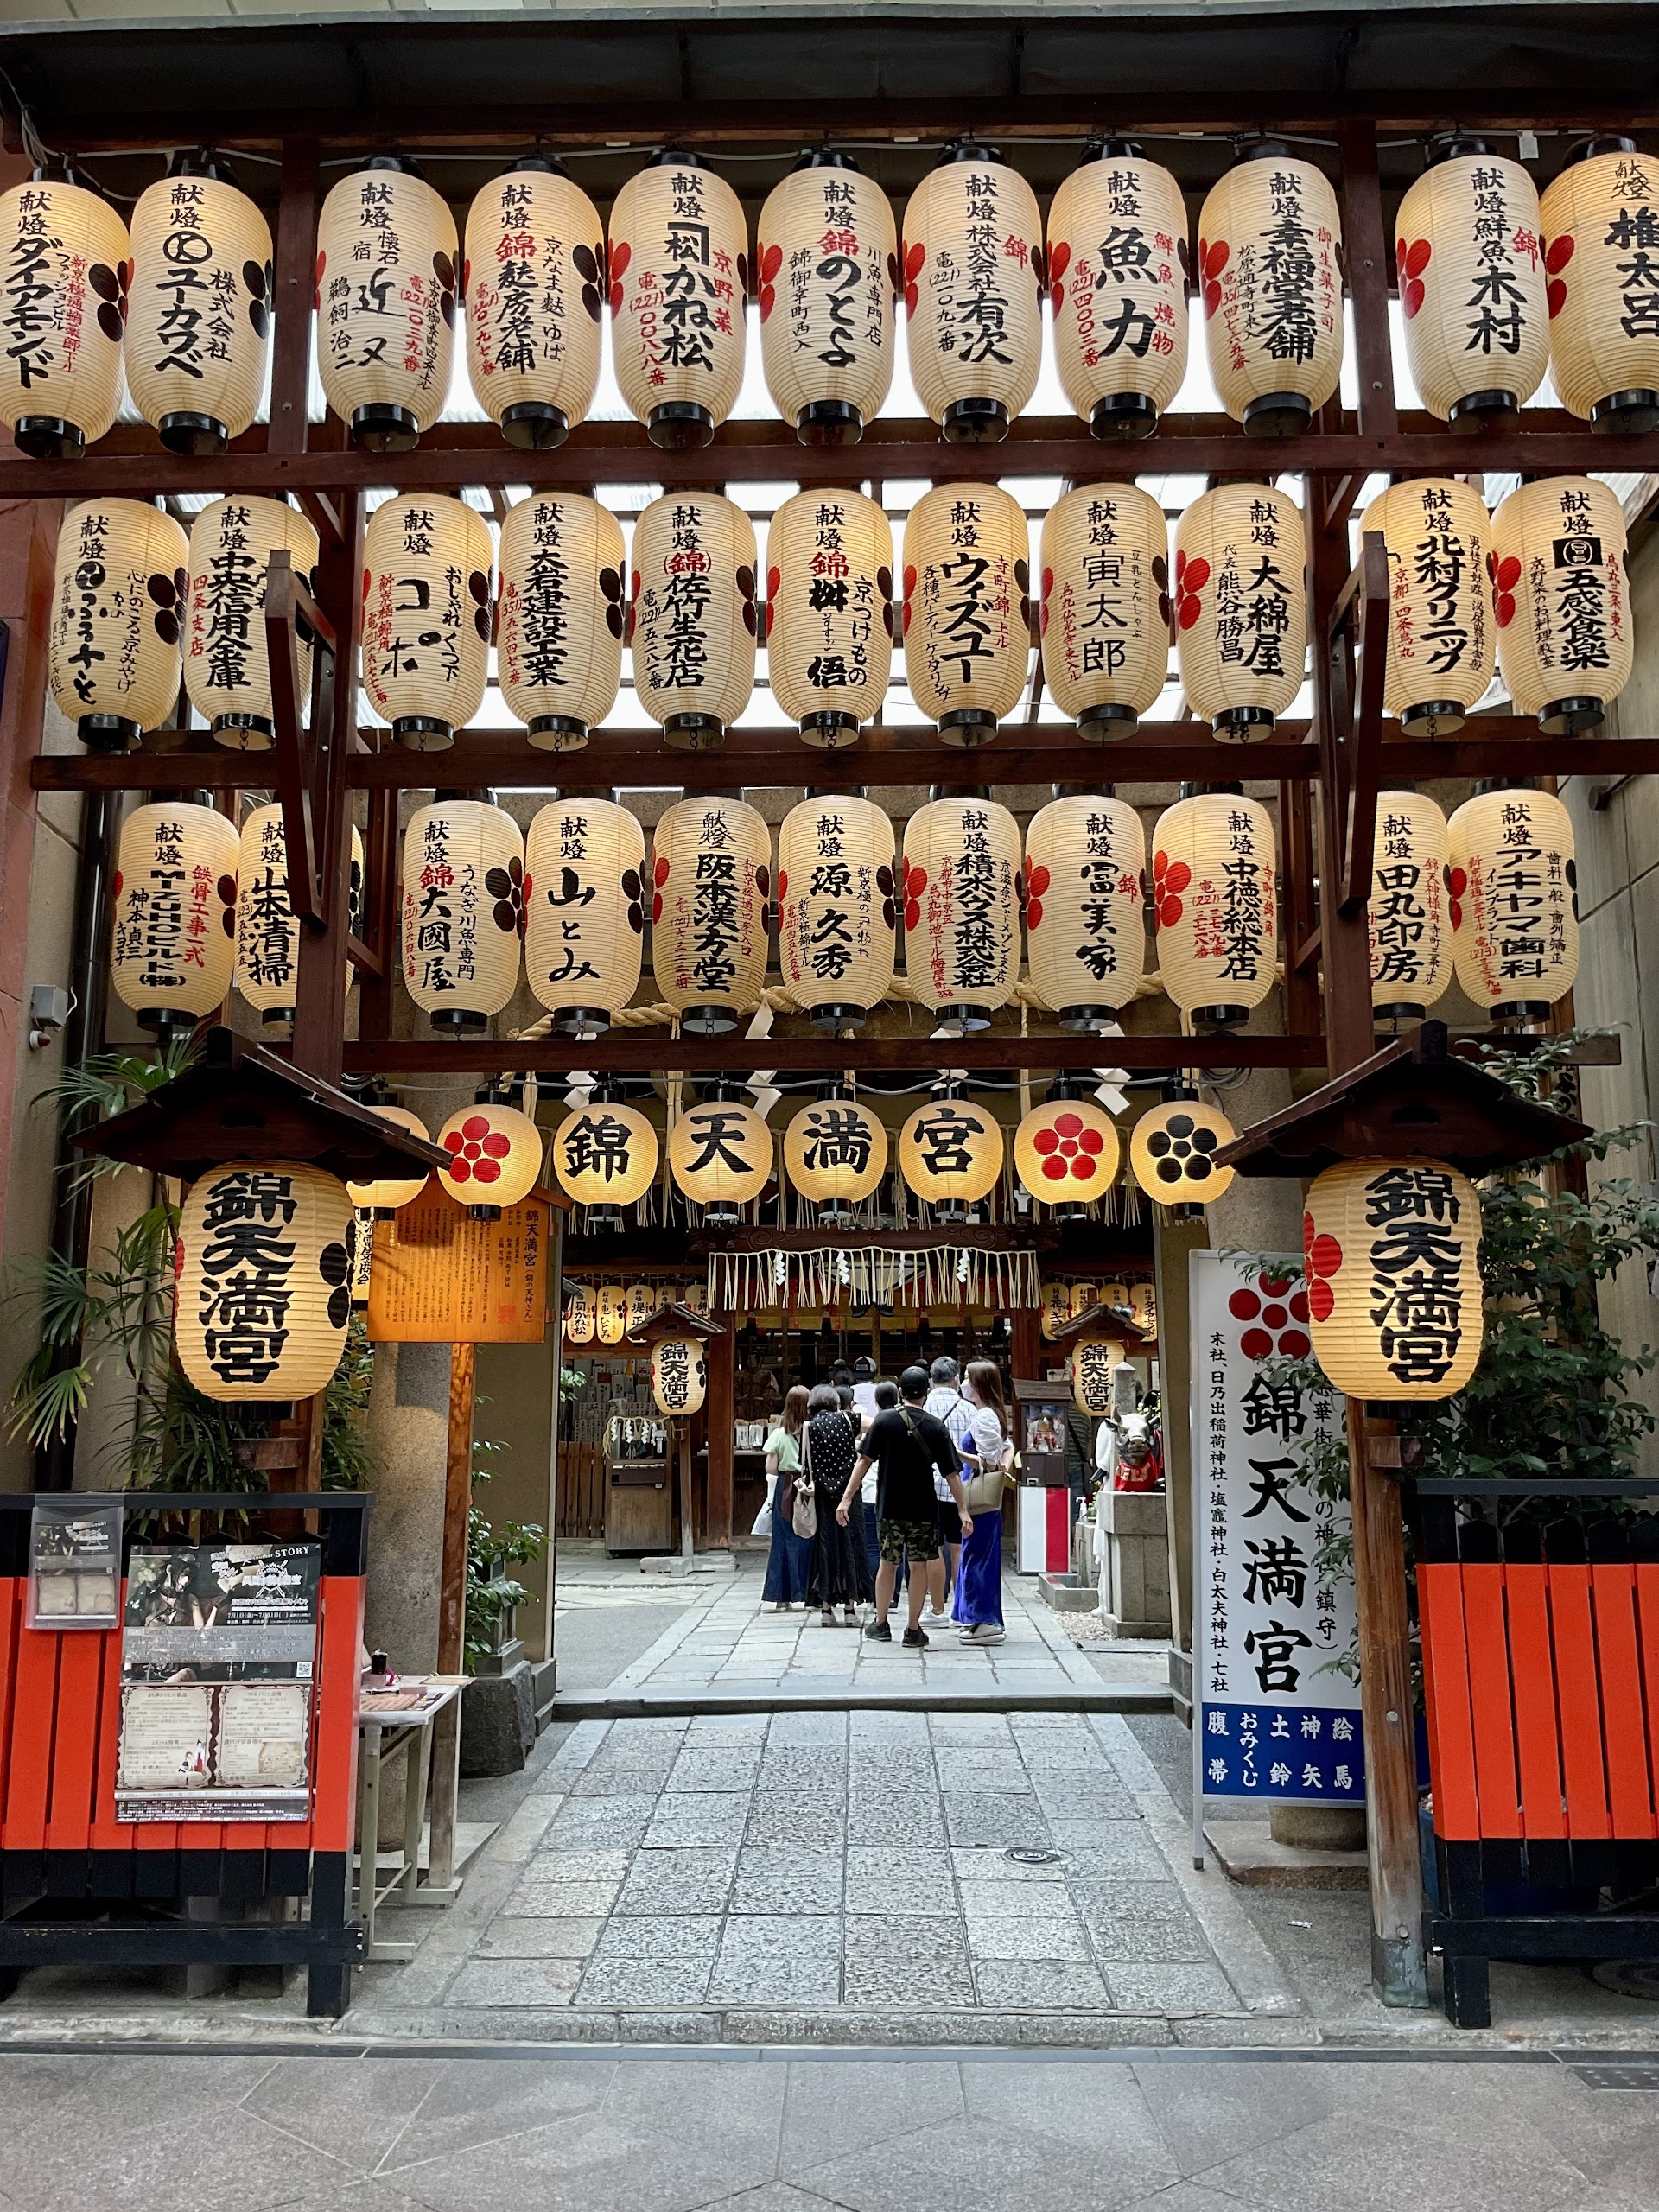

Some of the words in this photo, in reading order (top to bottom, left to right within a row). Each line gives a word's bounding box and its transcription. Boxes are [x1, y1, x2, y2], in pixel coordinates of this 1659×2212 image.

[671, 173, 705, 220] 献燈
[965, 175, 999, 219] 献燈
[1108, 171, 1142, 217] 献燈
[1270, 173, 1304, 219] 献燈
[1471, 168, 1506, 214] 献燈
[1611, 160, 1652, 200] 献燈
[17, 190, 52, 236] 献燈
[170, 183, 204, 231] 献燈
[361, 182, 394, 229] 献燈
[501, 184, 533, 229] 献燈
[823, 181, 857, 229] 献燈
[352, 241, 372, 261] 宿
[377, 231, 401, 265] 懐石
[495, 232, 537, 262] 錦
[817, 229, 860, 256] 錦
[965, 225, 1002, 292] 株式会社
[1002, 235, 1028, 270] 錦
[1511, 227, 1540, 272] 錦
[2, 237, 63, 389] ダイアモンド
[203, 270, 238, 362] 株式会社
[713, 249, 734, 336] 京野菜
[816, 257, 862, 367] のとよ
[865, 248, 883, 348] 川魚専門店
[1096, 226, 1158, 359] 魚力
[1465, 266, 1528, 355] 木村
[155, 267, 211, 378] ユーカワベ
[352, 268, 405, 370] 近又
[662, 266, 717, 372] かね松
[956, 292, 1013, 365] 有次
[220, 506, 250, 550] 献燈
[404, 510, 434, 555] 献燈
[533, 503, 563, 547] 献燈
[671, 506, 701, 550] 献燈
[815, 505, 845, 549] 献燈
[951, 502, 982, 547] 献燈
[1088, 501, 1117, 545] 献燈
[1249, 500, 1280, 548] 献燈
[1422, 489, 1453, 532] 献燈
[1560, 491, 1593, 536] 献燈
[79, 516, 109, 560] 献燈
[808, 551, 850, 579] 錦
[189, 575, 209, 658] 四条支店
[205, 551, 257, 690] 中央信用金庫
[442, 566, 463, 628] おしゃれ
[522, 549, 571, 688] 大岩建設工業
[939, 552, 995, 683] ウィズユー
[1080, 550, 1127, 678] 寅太郎
[1214, 573, 1247, 664] 熊谷勝昌
[1241, 555, 1293, 678] 大綿屋
[1414, 535, 1470, 675] 北村クリニック
[661, 574, 712, 690] 佐竹生花店
[847, 574, 874, 687] 京つけもの
[439, 632, 461, 682] くつ下
[154, 823, 183, 866] 献燈
[261, 822, 286, 864] 献燈
[423, 822, 450, 863] 献燈
[560, 817, 587, 861] 献燈
[698, 810, 735, 850] 献燈
[817, 815, 845, 858] 献燈
[962, 811, 989, 852] 献燈
[1086, 813, 1115, 858] 献燈
[1228, 811, 1255, 855] 献燈
[1383, 815, 1413, 858] 献燈
[1501, 804, 1532, 846] 献燈
[419, 864, 454, 890] 錦
[1117, 873, 1139, 903] 錦
[547, 866, 601, 982] 山とみ
[693, 854, 741, 993] 阪本漢方堂
[810, 864, 853, 981] 源久秀
[952, 854, 998, 989] 積水ハウス株式会社
[1216, 857, 1262, 980] 中徳総本店
[1375, 864, 1425, 983] 田丸印房
[1495, 849, 1548, 980] アキヤマ歯科
[563, 1115, 633, 1184] 錦
[685, 1111, 754, 1173] 天
[802, 1108, 874, 1175] 満
[913, 1107, 985, 1176] 宮
[523, 1209, 540, 1267] 錦天満宮
[198, 1170, 299, 1385] 錦天満宮
[1363, 1166, 1465, 1384] 錦天満宮
[660, 1341, 690, 1410] 錦天満宮
[1080, 1343, 1113, 1412] 錦天満宮
[275, 1546, 309, 1558] STORY
[1238, 1372, 1313, 1694] 錦天満宮
[1207, 1710, 1230, 1784] 腹帯
[1238, 1712, 1259, 1789] おみくじ
[1269, 1713, 1293, 1787] 土鈴
[1300, 1714, 1323, 1789] 神矢
[1332, 1716, 1355, 1790] 絵馬
